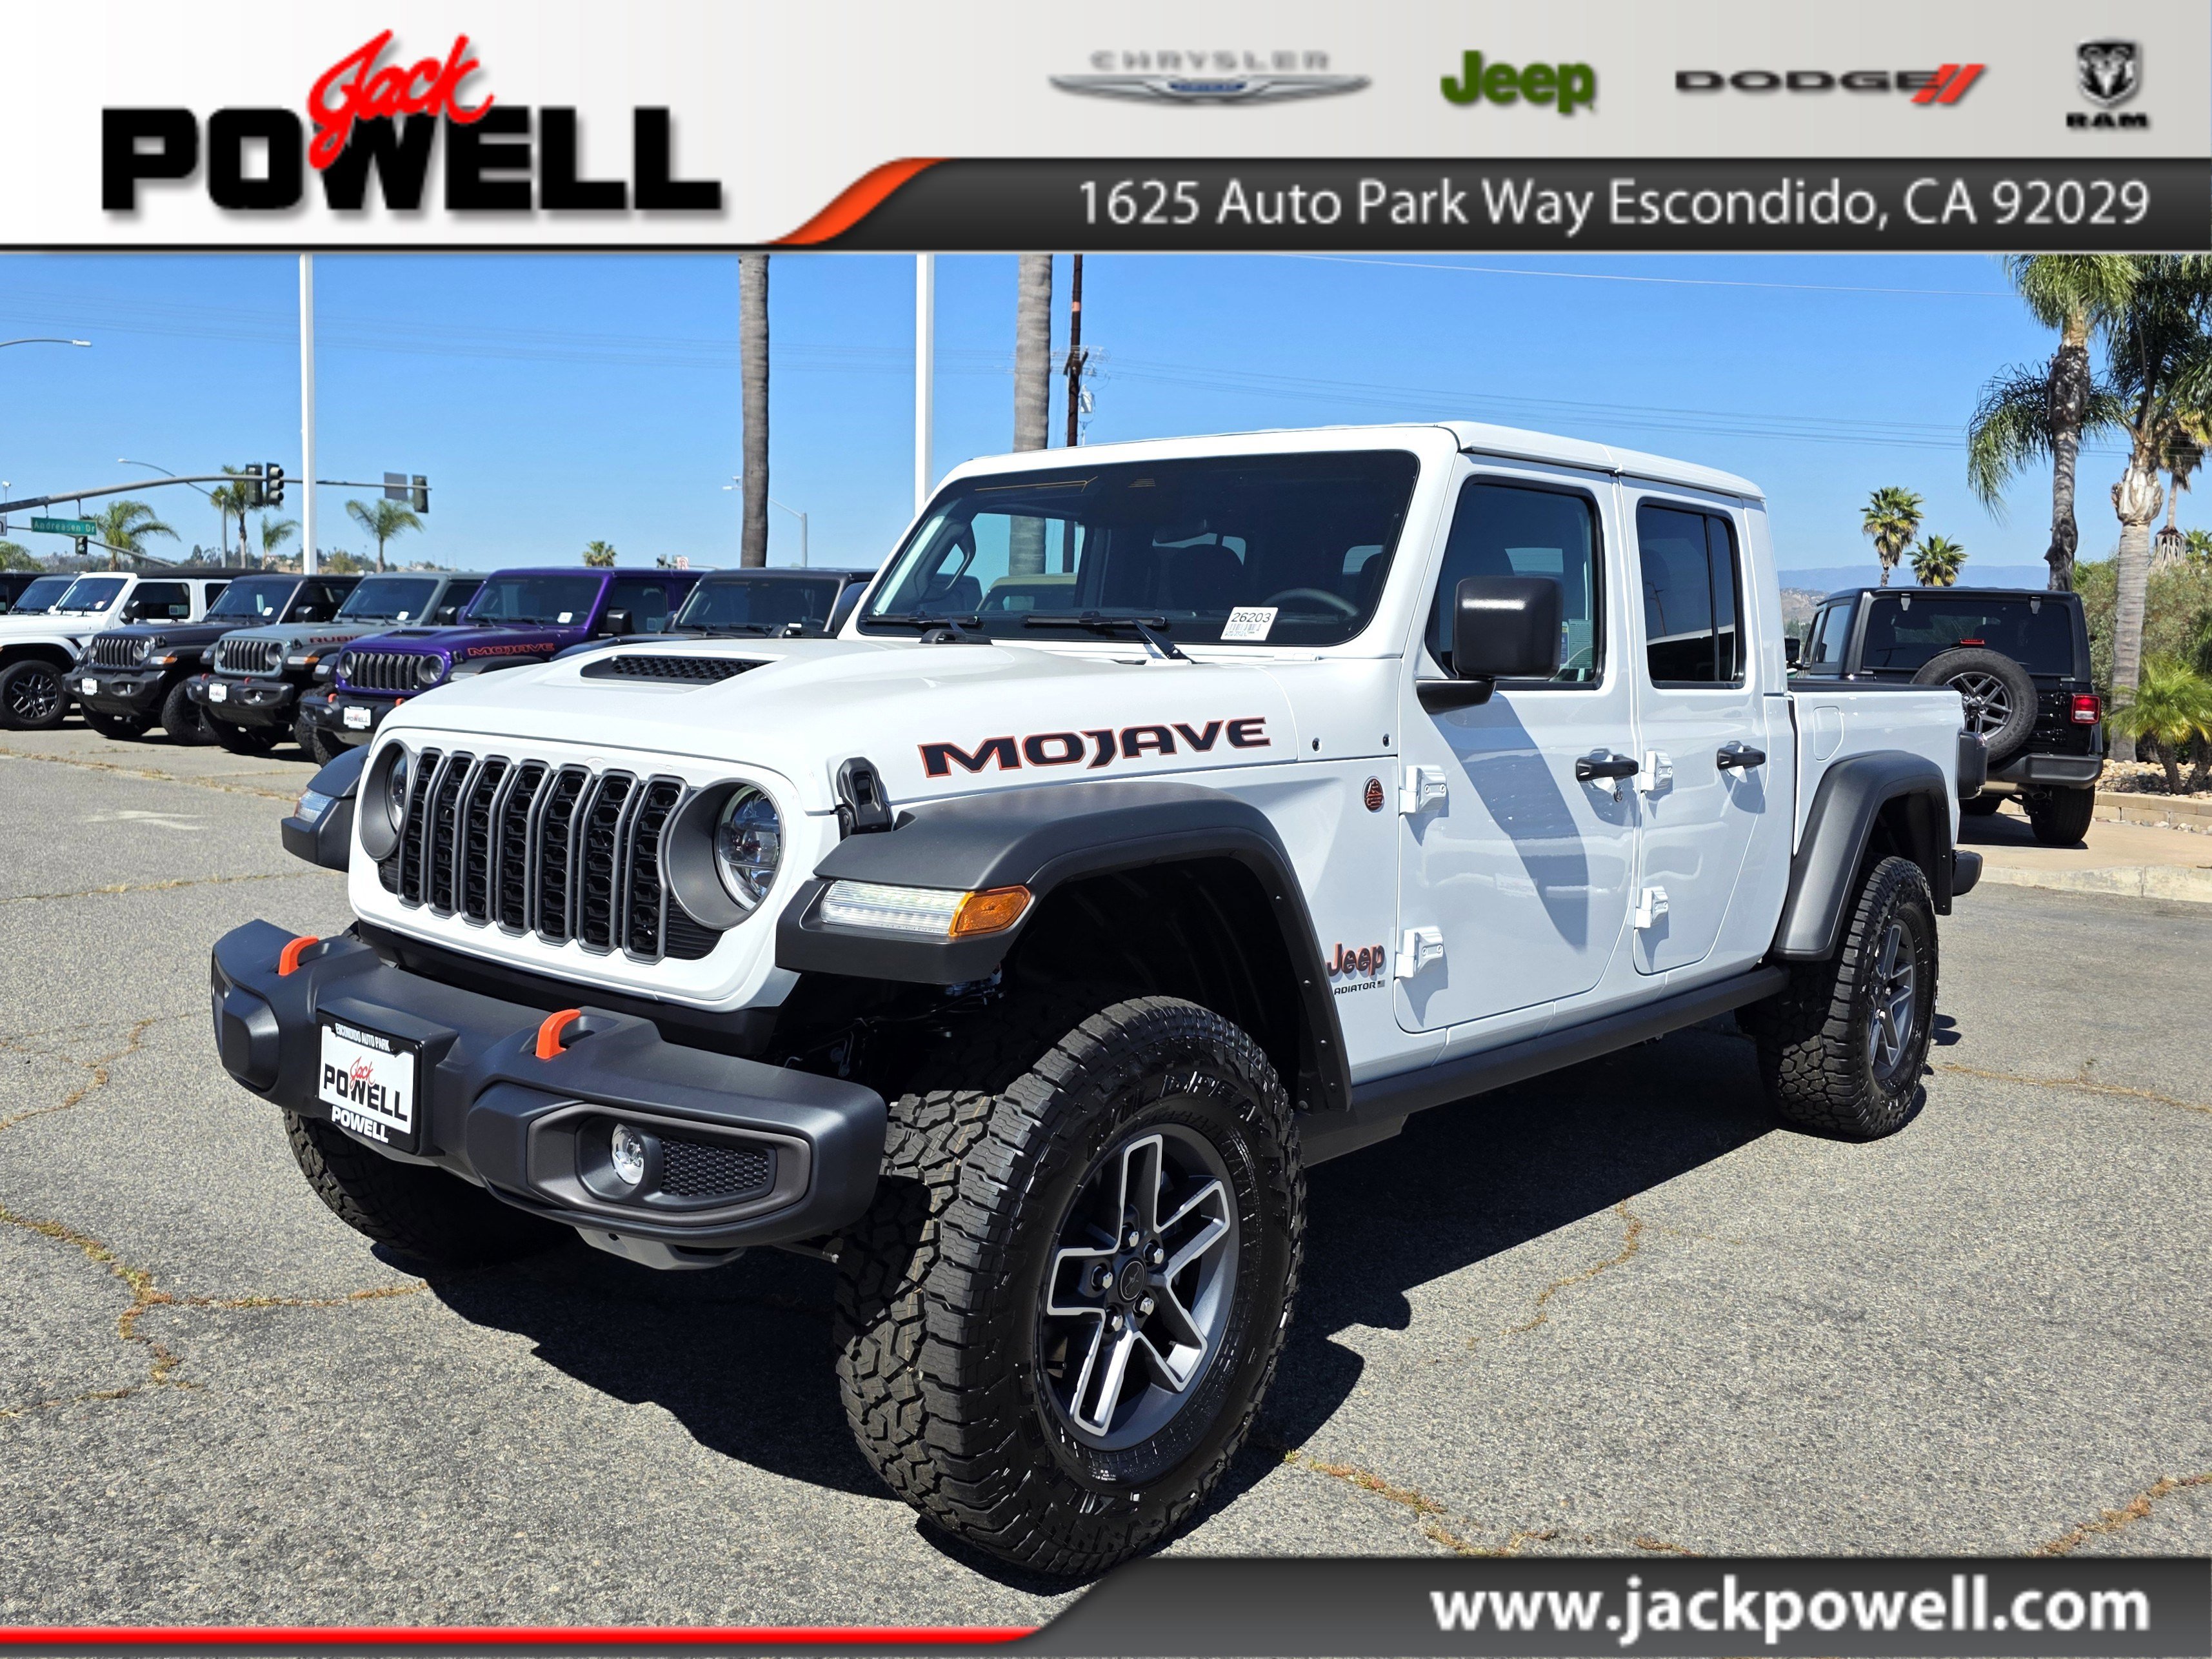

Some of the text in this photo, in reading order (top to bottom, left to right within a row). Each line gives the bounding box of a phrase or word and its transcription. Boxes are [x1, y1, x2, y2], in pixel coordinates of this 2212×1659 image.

[34, 521, 95, 532] Andreasen Dr
[1231, 612, 1271, 623] 26203
[468, 643, 555, 656] MOJAVE
[917, 716, 1271, 778] MOJAVE
[1326, 943, 1386, 976] Jeep
[1333, 981, 1375, 995] ADIATOR
[361, 1032, 375, 1047] AUTO
[375, 1036, 390, 1052] PARK
[350, 1056, 375, 1090] Jack
[324, 1063, 408, 1122] POWELL
[332, 1105, 389, 1143] POWELL
